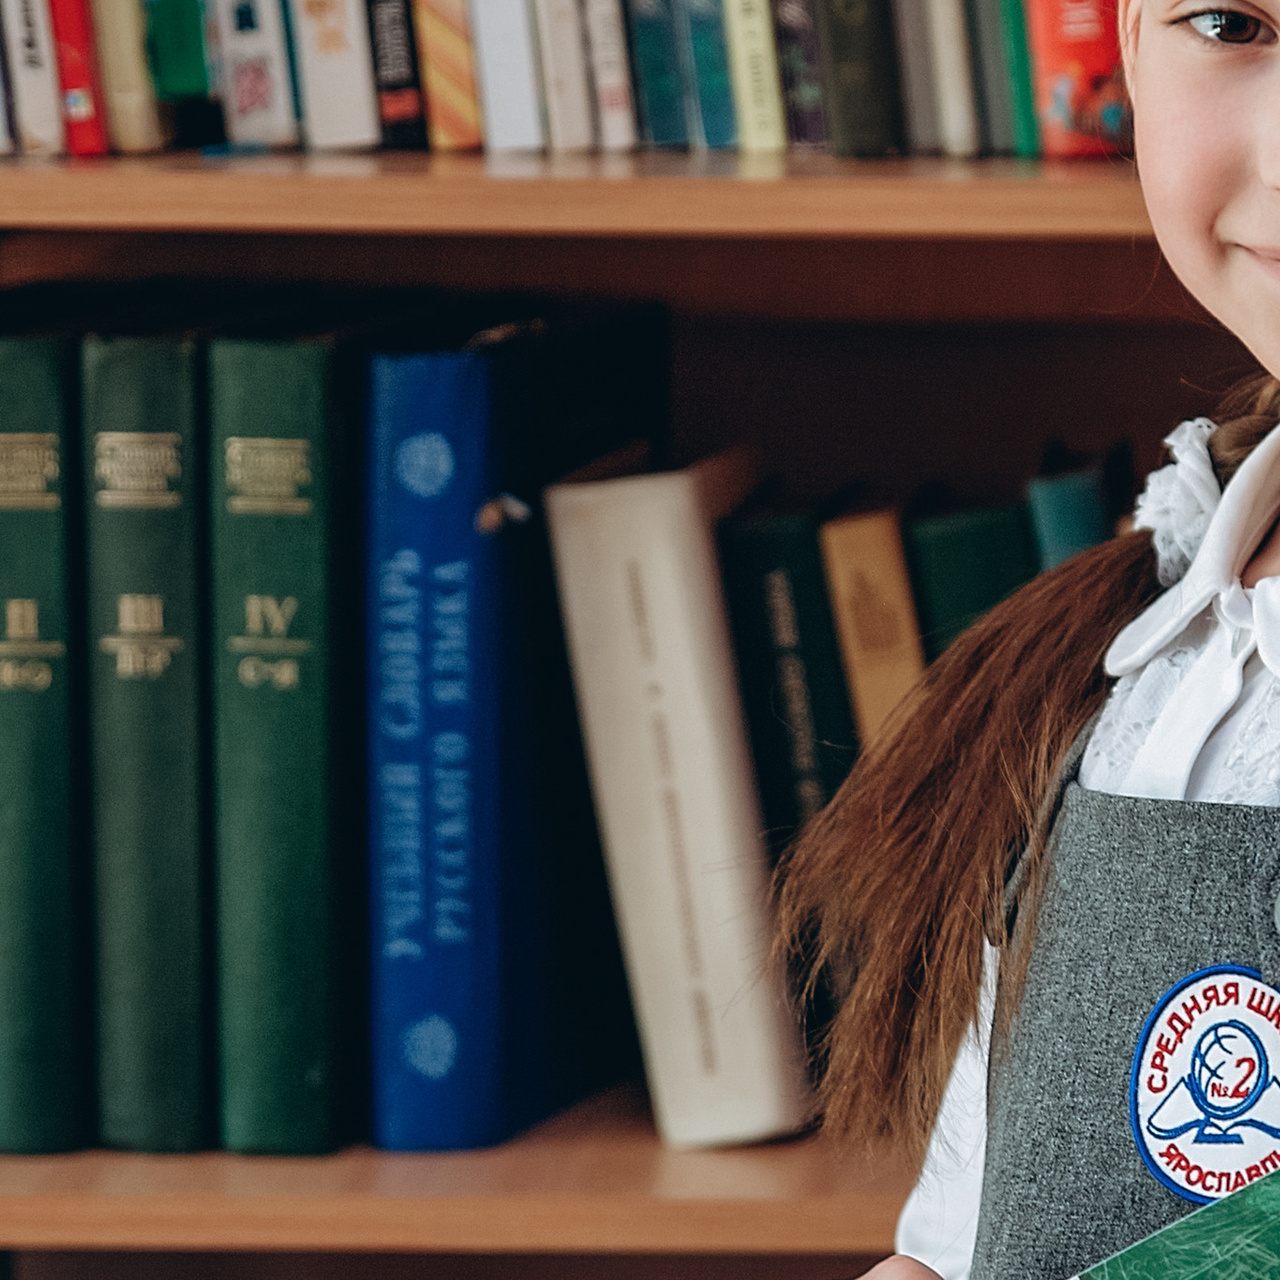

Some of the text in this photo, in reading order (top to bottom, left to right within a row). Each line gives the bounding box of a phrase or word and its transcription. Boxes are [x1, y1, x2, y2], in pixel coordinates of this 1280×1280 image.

[118, 593, 165, 635] III
[243, 594, 300, 637] IV
[379, 548, 424, 959] УЧЕБНЫЙ СЛОВАРЬ
[429, 559, 471, 941] РУССКОГО ЯЗЫКА
[1147, 982, 1239, 1094] СРЕДНЯЯ
